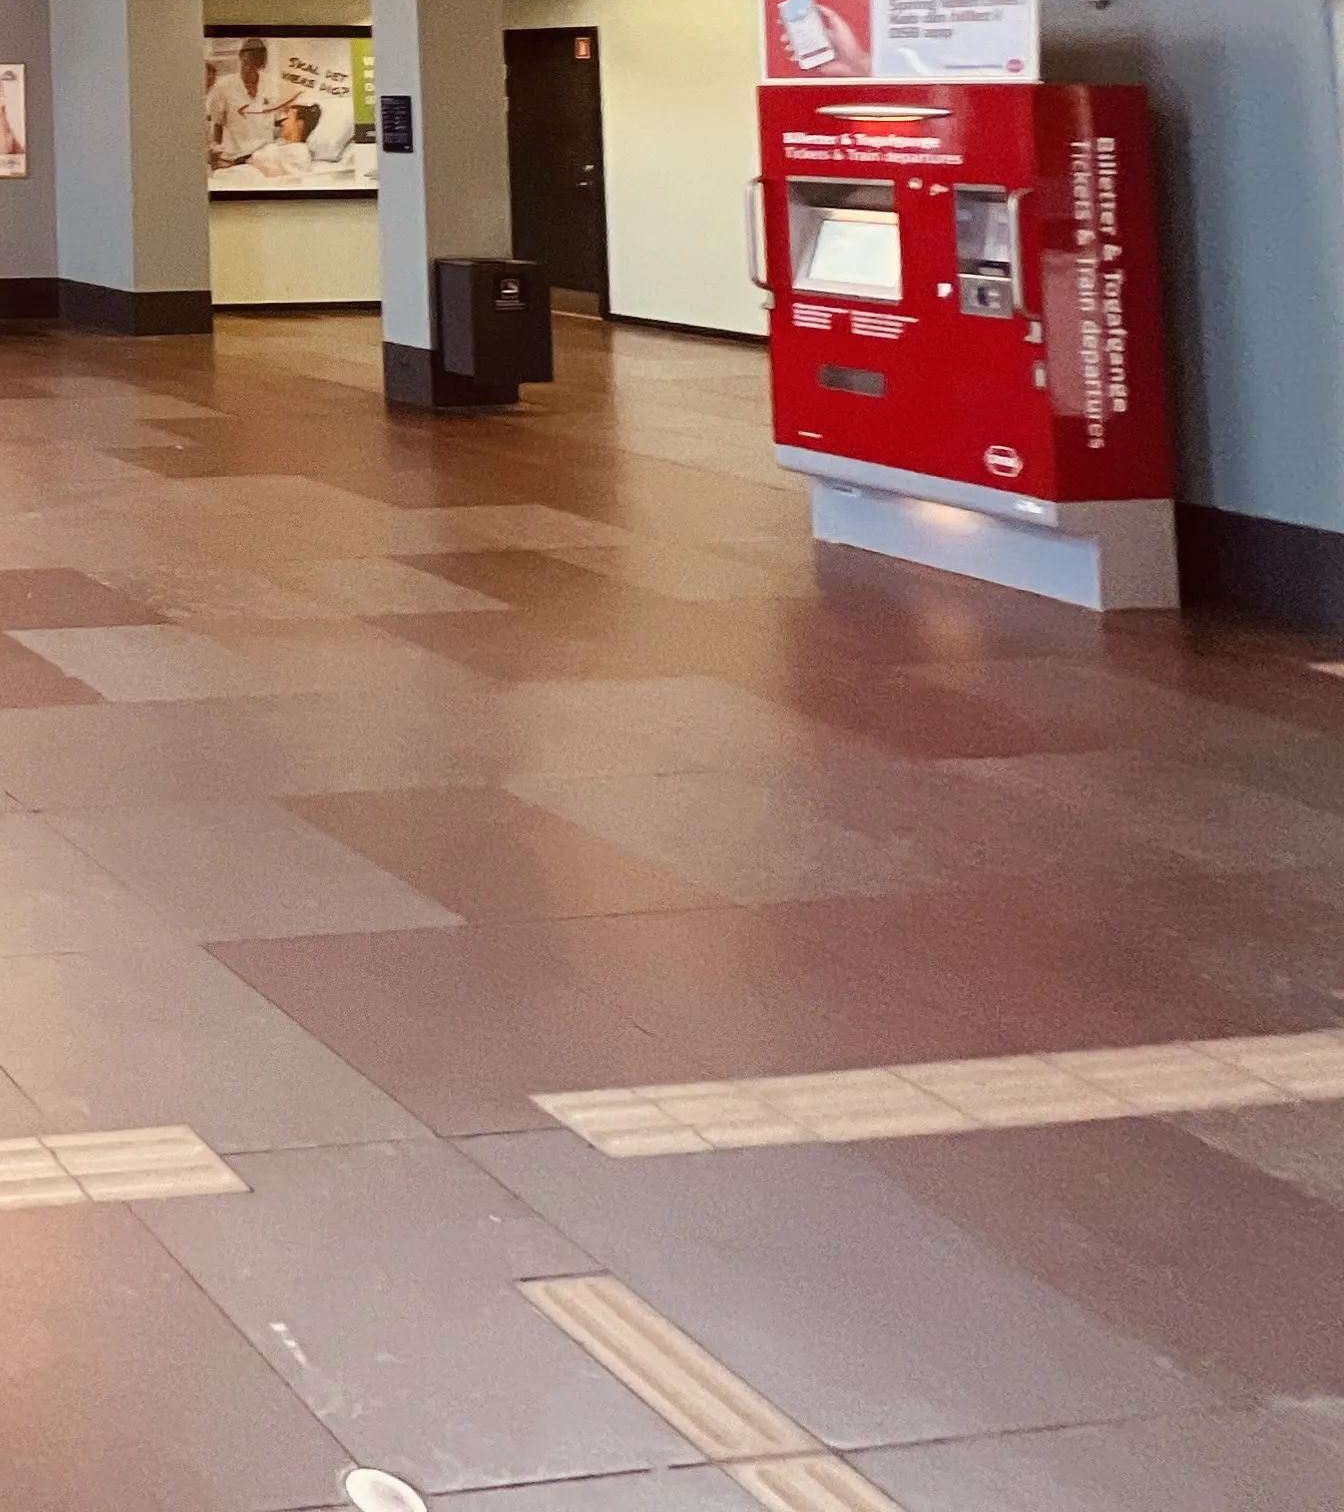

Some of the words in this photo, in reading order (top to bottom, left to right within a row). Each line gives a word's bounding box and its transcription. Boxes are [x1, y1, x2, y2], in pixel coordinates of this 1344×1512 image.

[883, 151, 964, 165] departures
[1070, 141, 1093, 221] Tickets
[1097, 137, 1118, 236] Billetter
[1076, 228, 1097, 246] &
[1102, 243, 1123, 262] &
[1076, 257, 1098, 312] Train
[1103, 269, 1128, 413] Togafgange
[1079, 320, 1105, 449] departures
